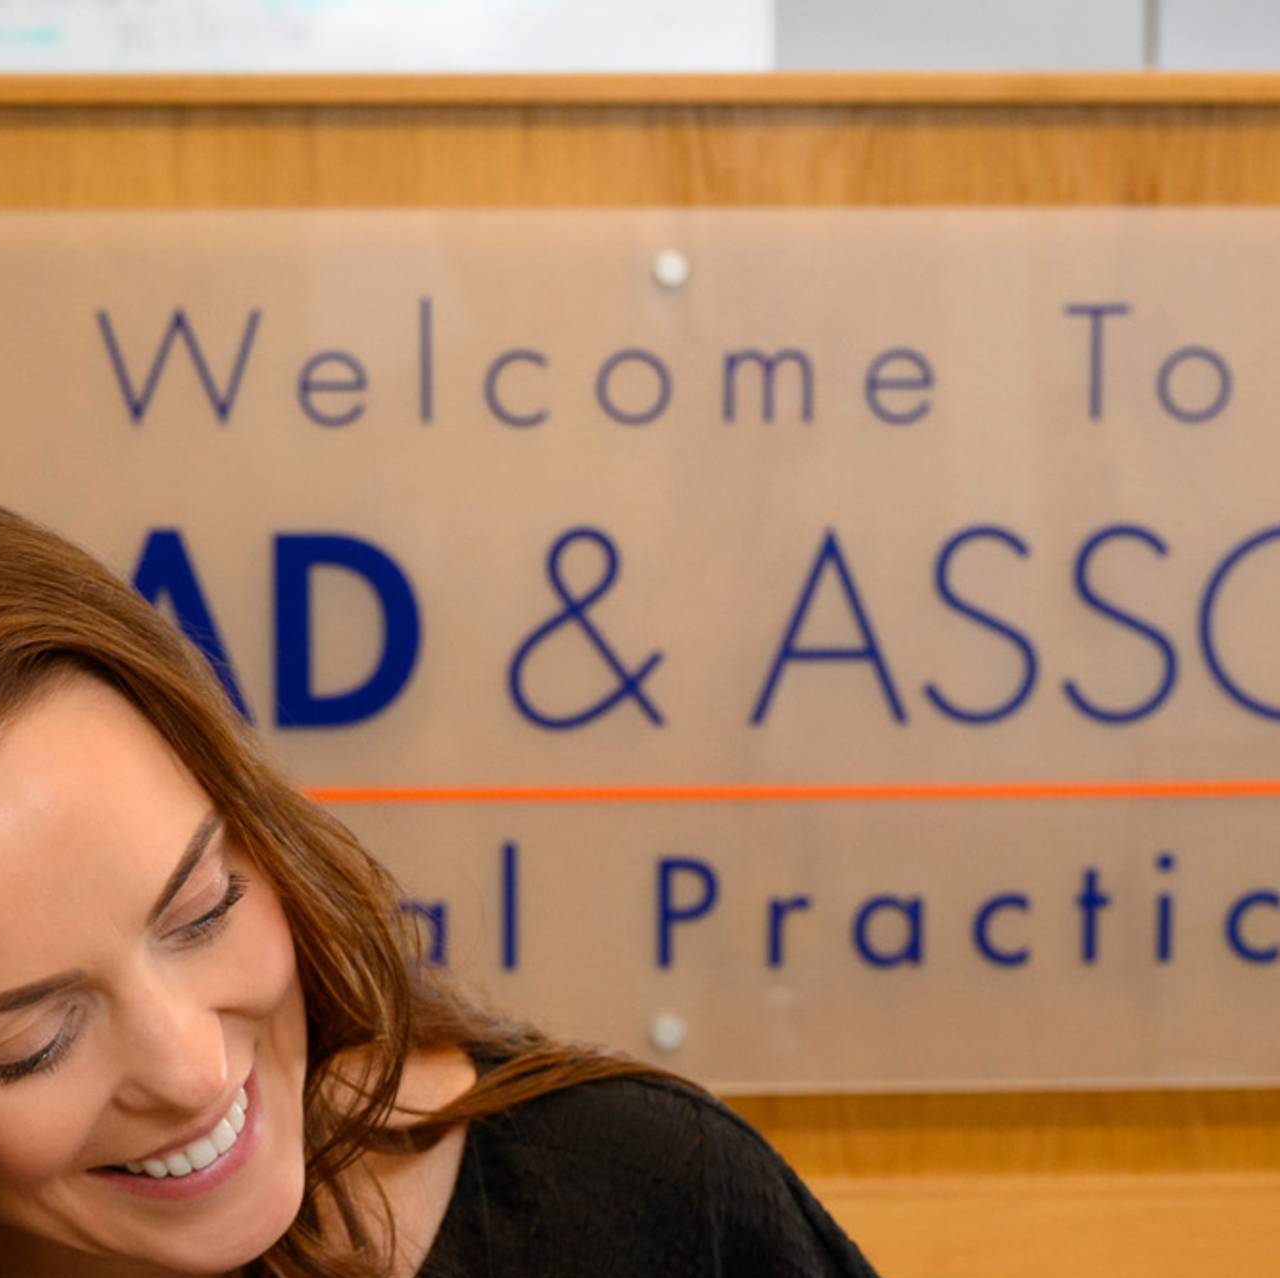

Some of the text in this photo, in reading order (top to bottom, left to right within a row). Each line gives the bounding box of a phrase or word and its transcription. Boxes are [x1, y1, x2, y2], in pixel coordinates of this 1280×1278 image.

[95, 296, 1233, 427] Welcome To
[507, 525, 665, 733] &
